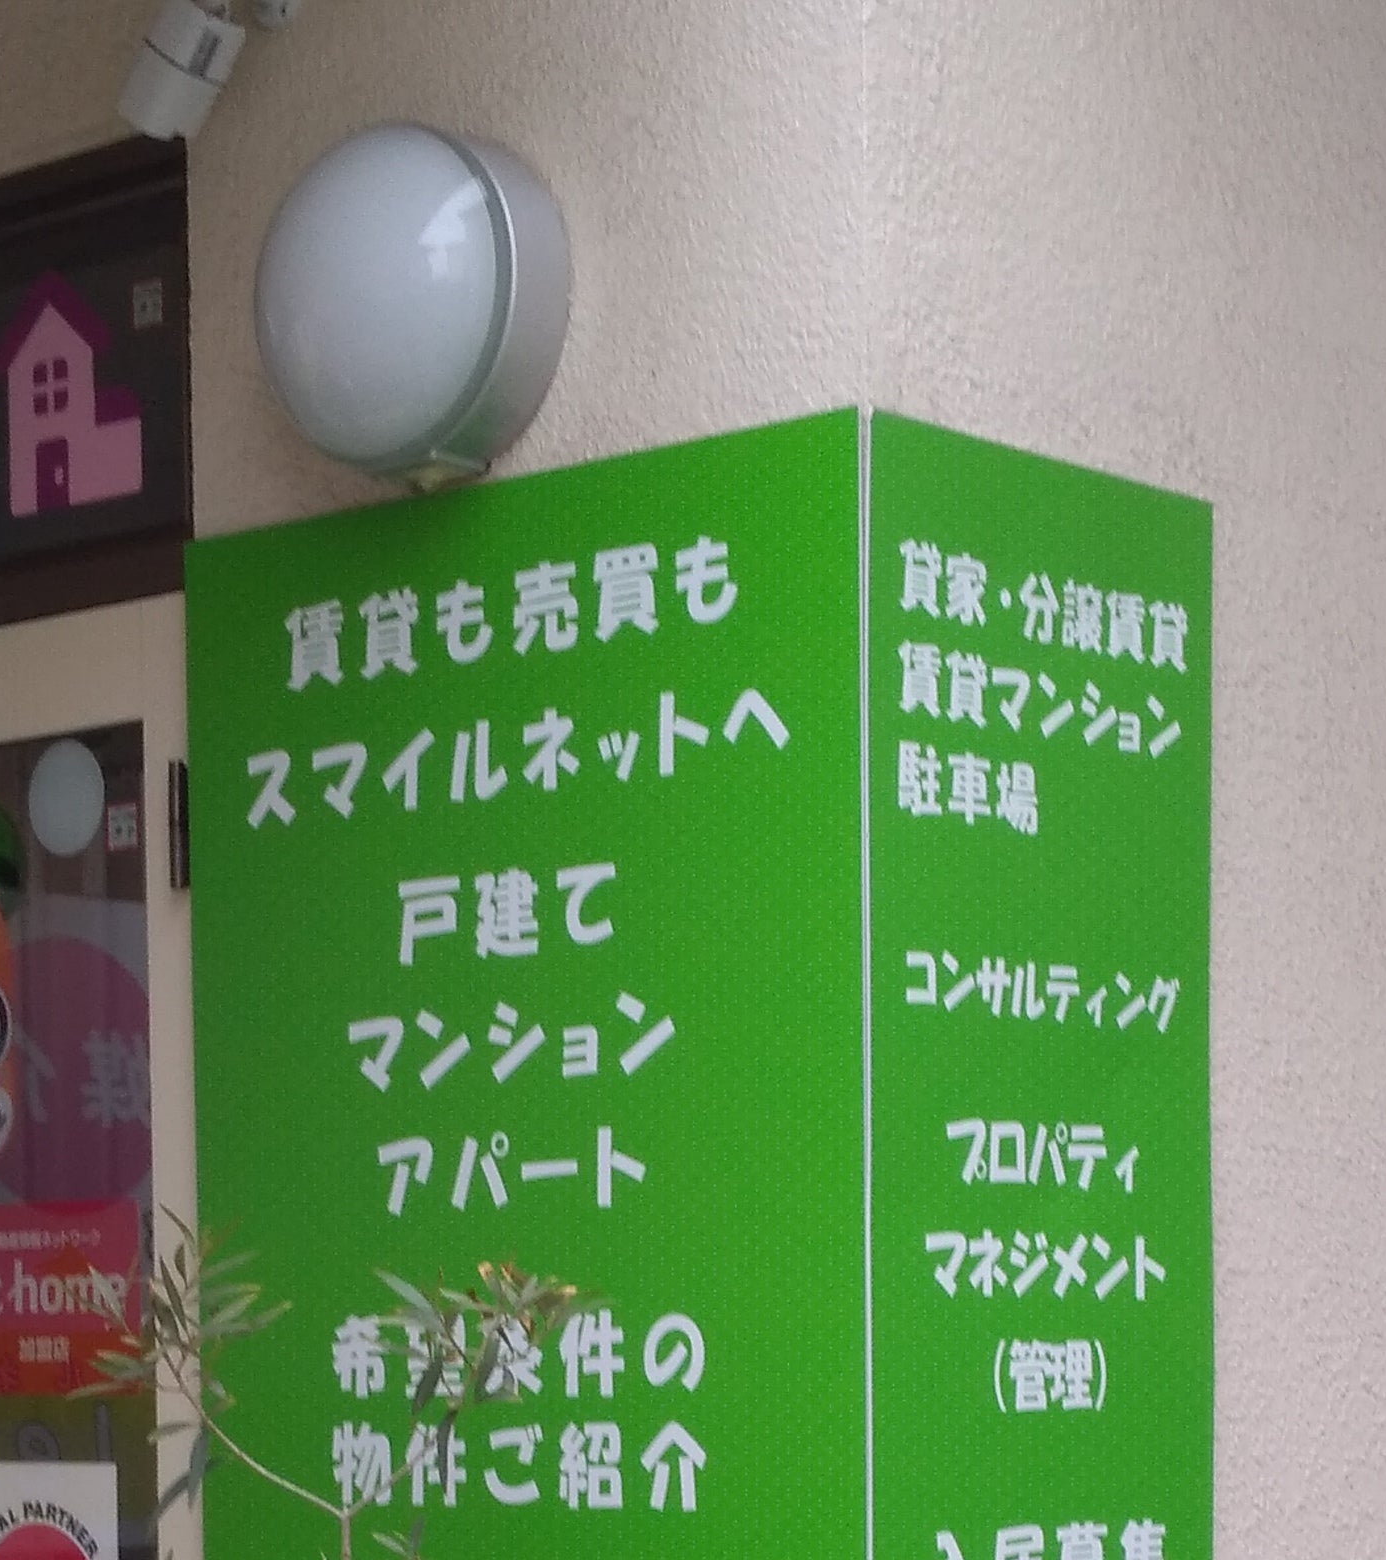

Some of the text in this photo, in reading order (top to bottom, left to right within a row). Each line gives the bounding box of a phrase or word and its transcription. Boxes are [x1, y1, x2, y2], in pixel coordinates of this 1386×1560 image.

[284, 536, 739, 692] 賃貸も売買も
[897, 639, 1183, 760] 賃貸マンション
[245, 687, 791, 830] スマイルネットへ
[897, 739, 1040, 835] 駐車場
[398, 862, 616, 966] 戸建て
[905, 950, 1181, 1033] コンサルティング
[347, 991, 676, 1092] マンション
[377, 1125, 646, 1216] アパート
[945, 1118, 1140, 1193] プロパティ
[924, 1229, 1167, 1301] マネジメント
[331, 1420, 708, 1513] 物件ご紹介
